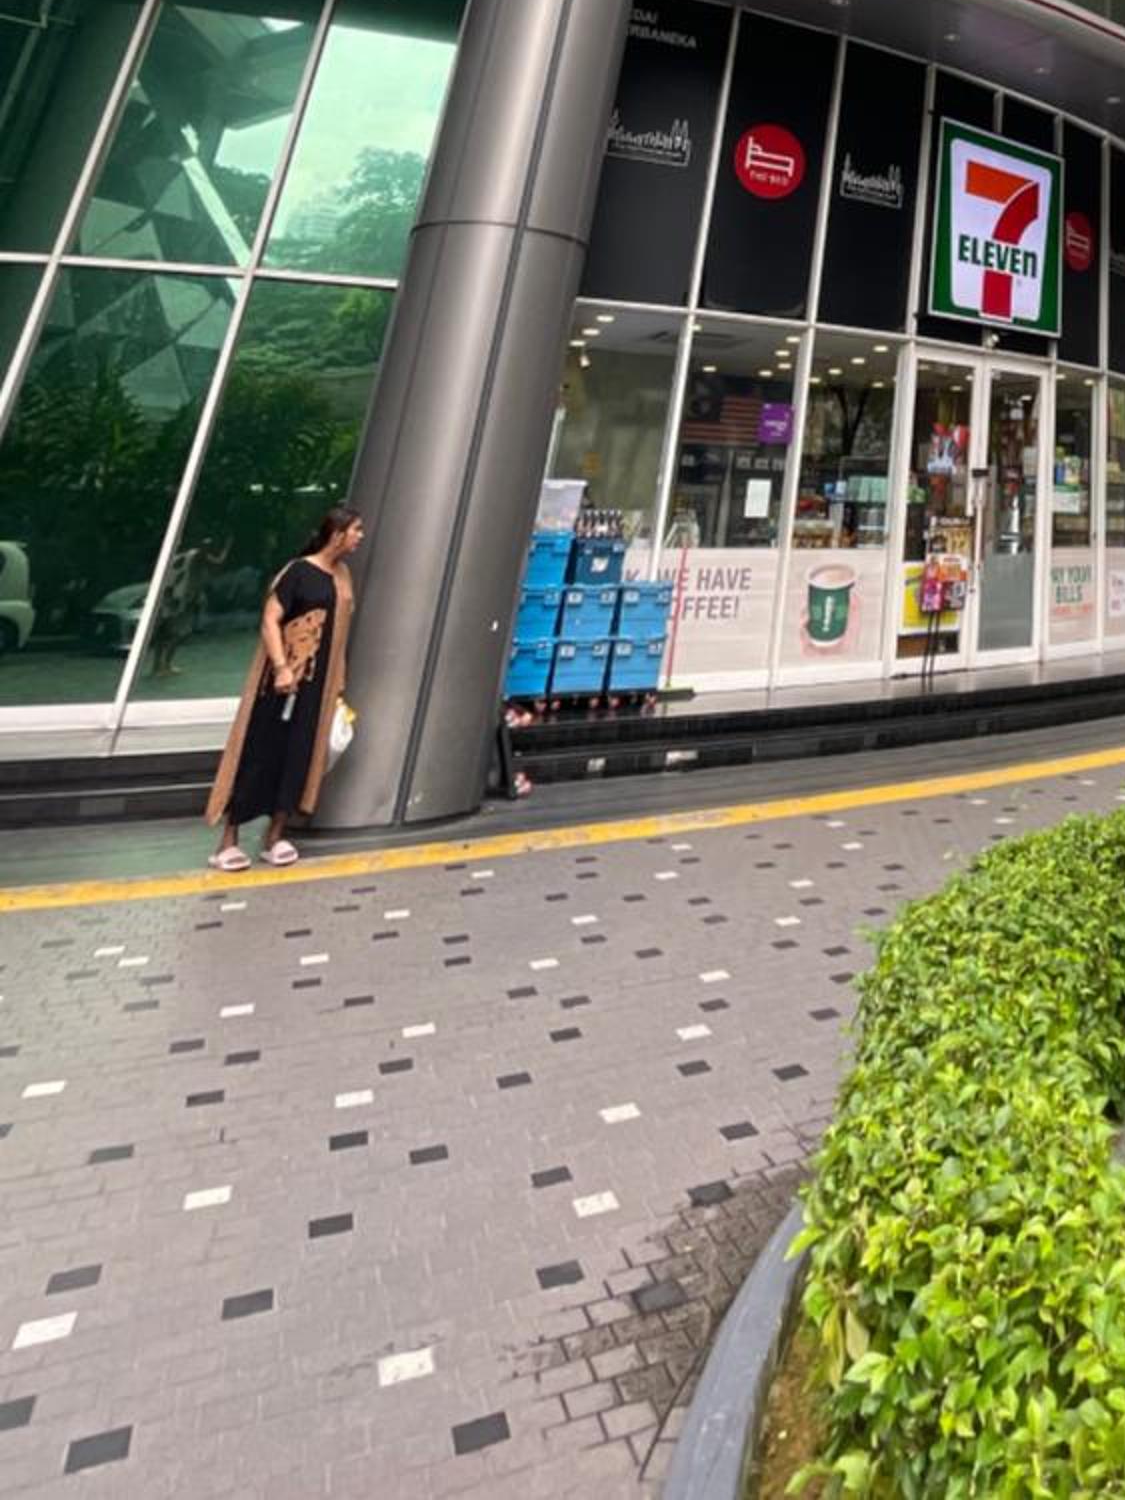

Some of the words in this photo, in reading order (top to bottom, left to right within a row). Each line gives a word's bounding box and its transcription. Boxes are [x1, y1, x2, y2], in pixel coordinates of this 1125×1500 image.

[630, 8, 657, 25] DAI
[965, 160, 1040, 246] 7
[696, 567, 752, 591] HAVE
[668, 595, 740, 620] FFEE!
